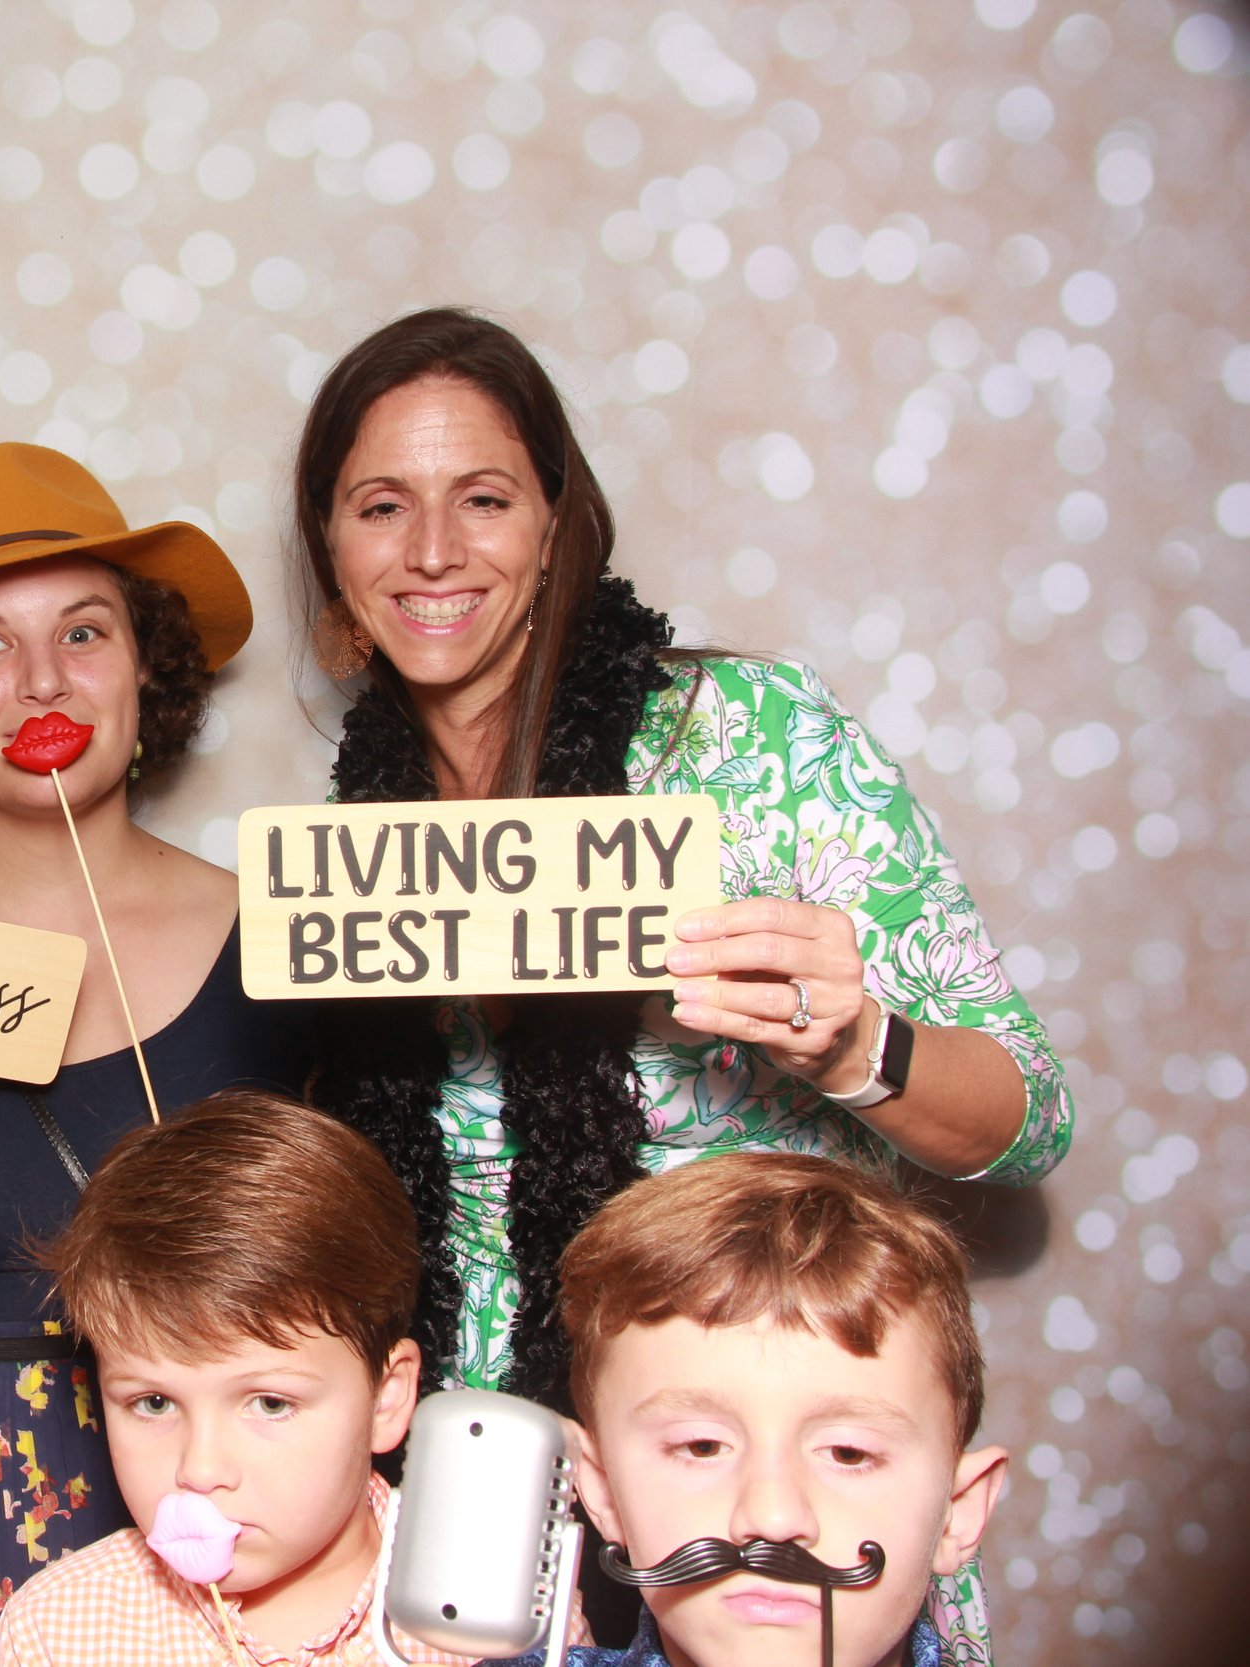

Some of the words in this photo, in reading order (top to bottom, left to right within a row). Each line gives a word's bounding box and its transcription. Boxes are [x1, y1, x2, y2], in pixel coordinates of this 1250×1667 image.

[267, 819, 537, 899] LIVING
[576, 816, 693, 892] MY
[288, 909, 471, 985] BEST
[511, 905, 672, 981] LIFE
